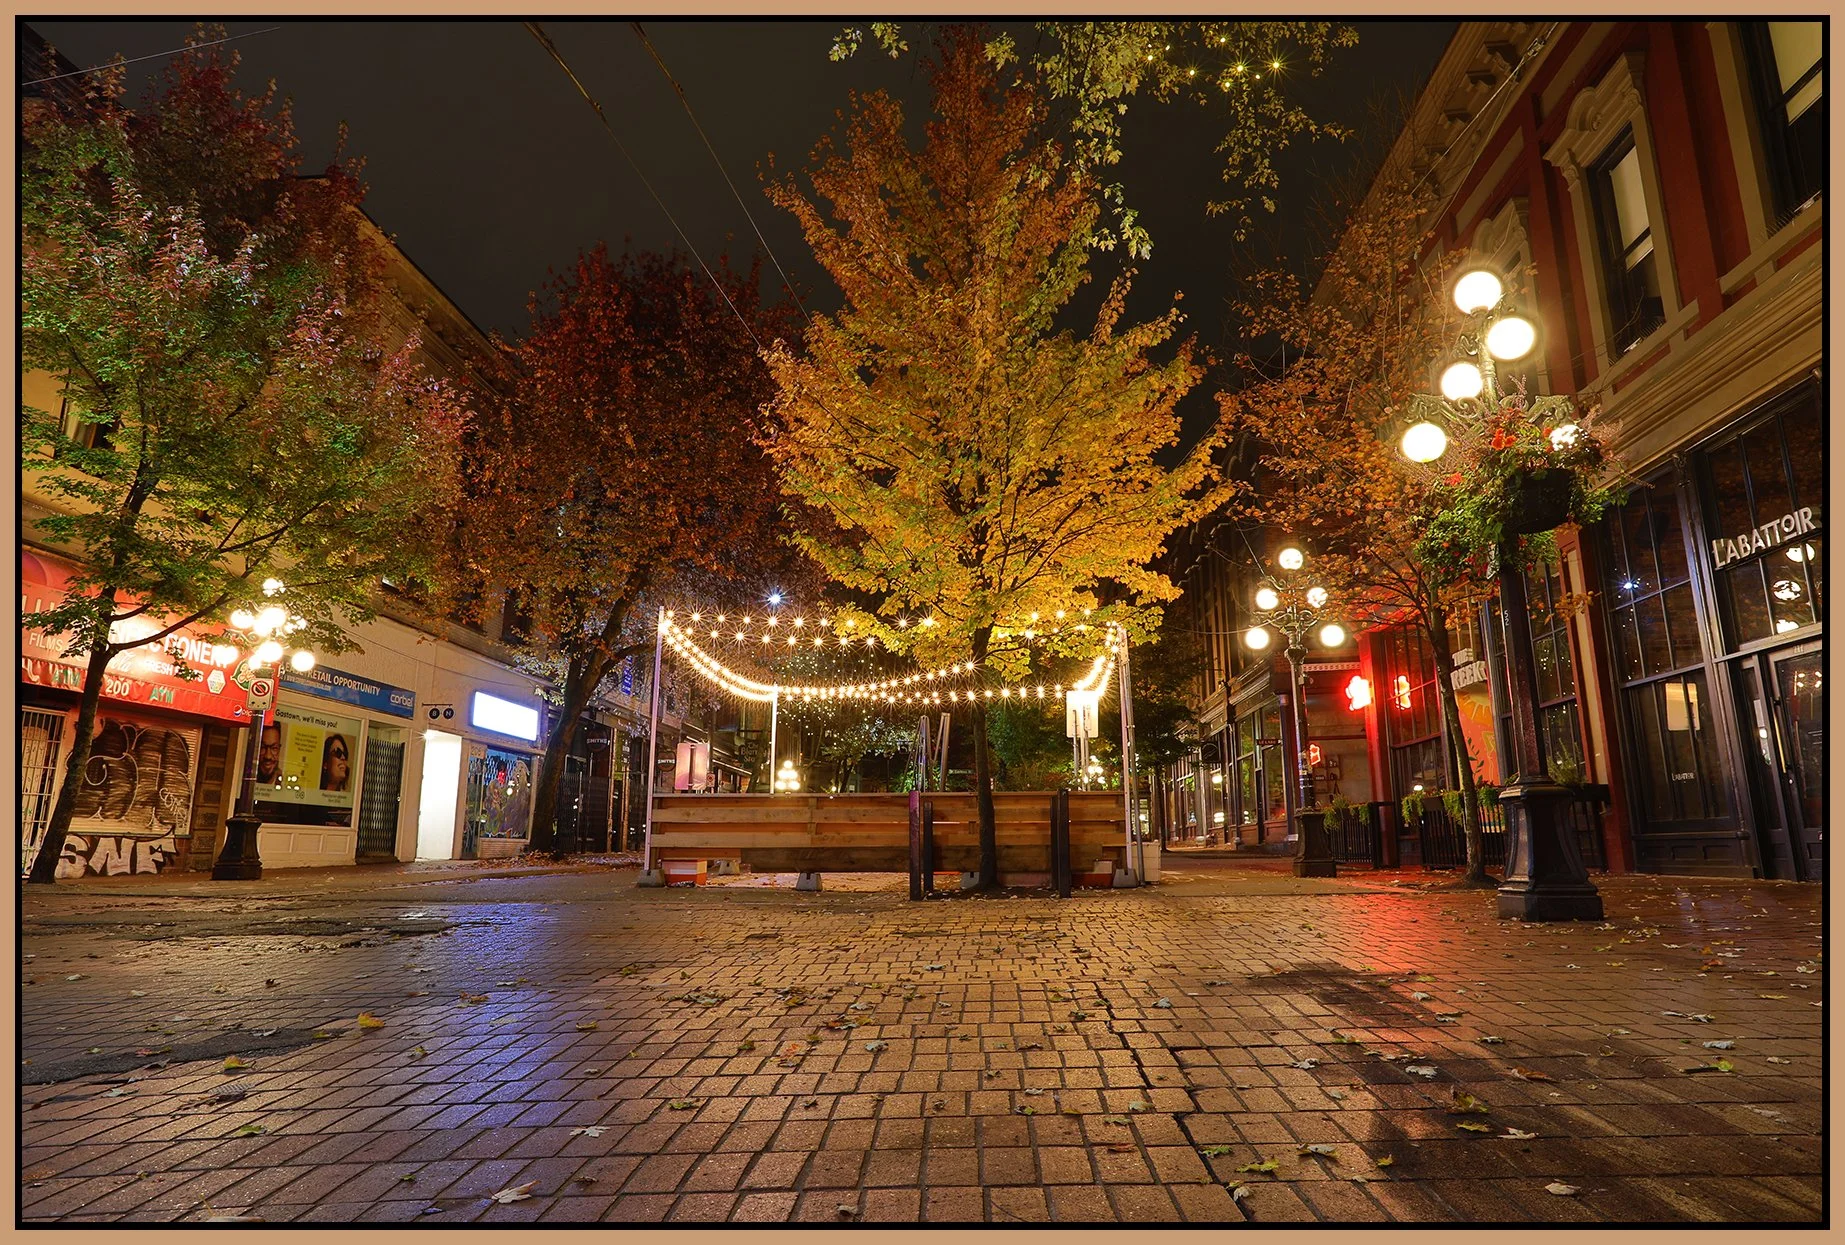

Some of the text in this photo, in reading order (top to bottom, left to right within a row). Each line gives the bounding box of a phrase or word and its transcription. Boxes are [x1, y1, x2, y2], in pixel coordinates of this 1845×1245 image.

[1712, 506, 1817, 571] L'ABATTOIR
[28, 631, 64, 652] FILMS
[144, 659, 174, 677] FRESH
[1450, 660, 1488, 691] REEK
[307, 669, 332, 684] RETAIL
[333, 675, 381, 696] OPPORTUNITY
[275, 708, 338, 729] Gastown, we'll miss you!
[657, 757, 676, 765] SMITHS
